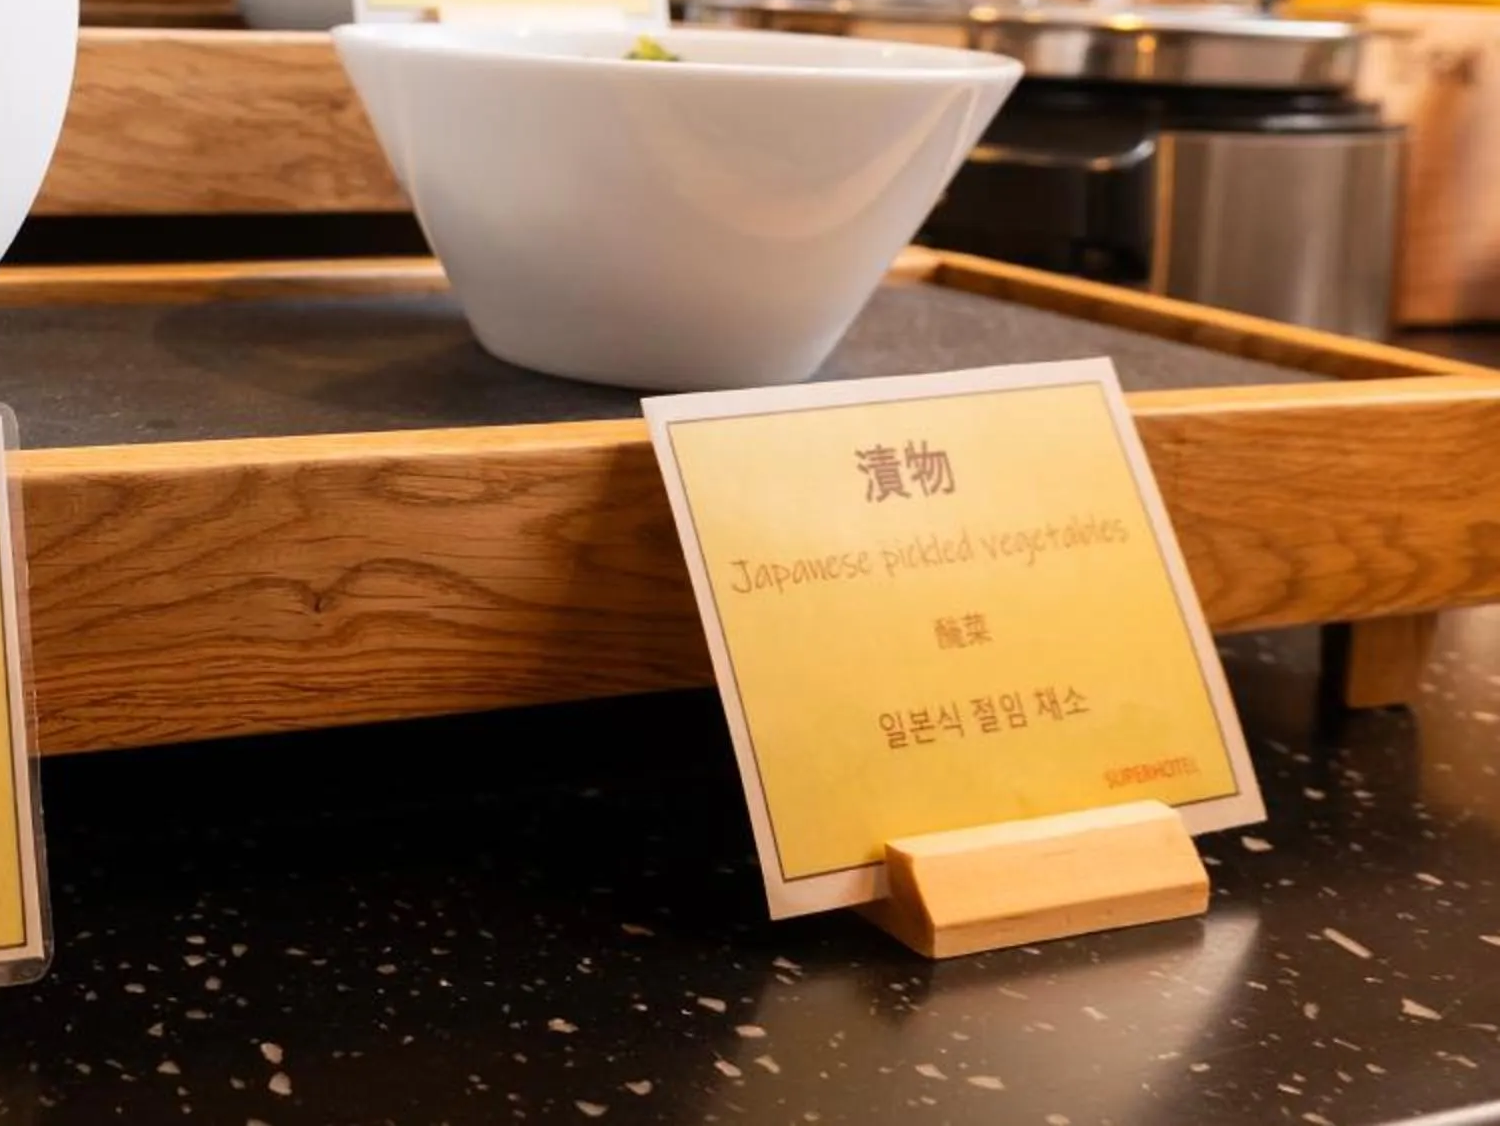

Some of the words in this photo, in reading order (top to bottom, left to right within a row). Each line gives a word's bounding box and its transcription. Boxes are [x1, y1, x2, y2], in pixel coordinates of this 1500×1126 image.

[855, 440, 956, 503] 漬物
[728, 549, 872, 595] Japanese
[883, 527, 975, 576] pickled
[982, 513, 1130, 568] vegetables
[879, 701, 966, 750] 일본식
[969, 691, 1029, 734] 절임
